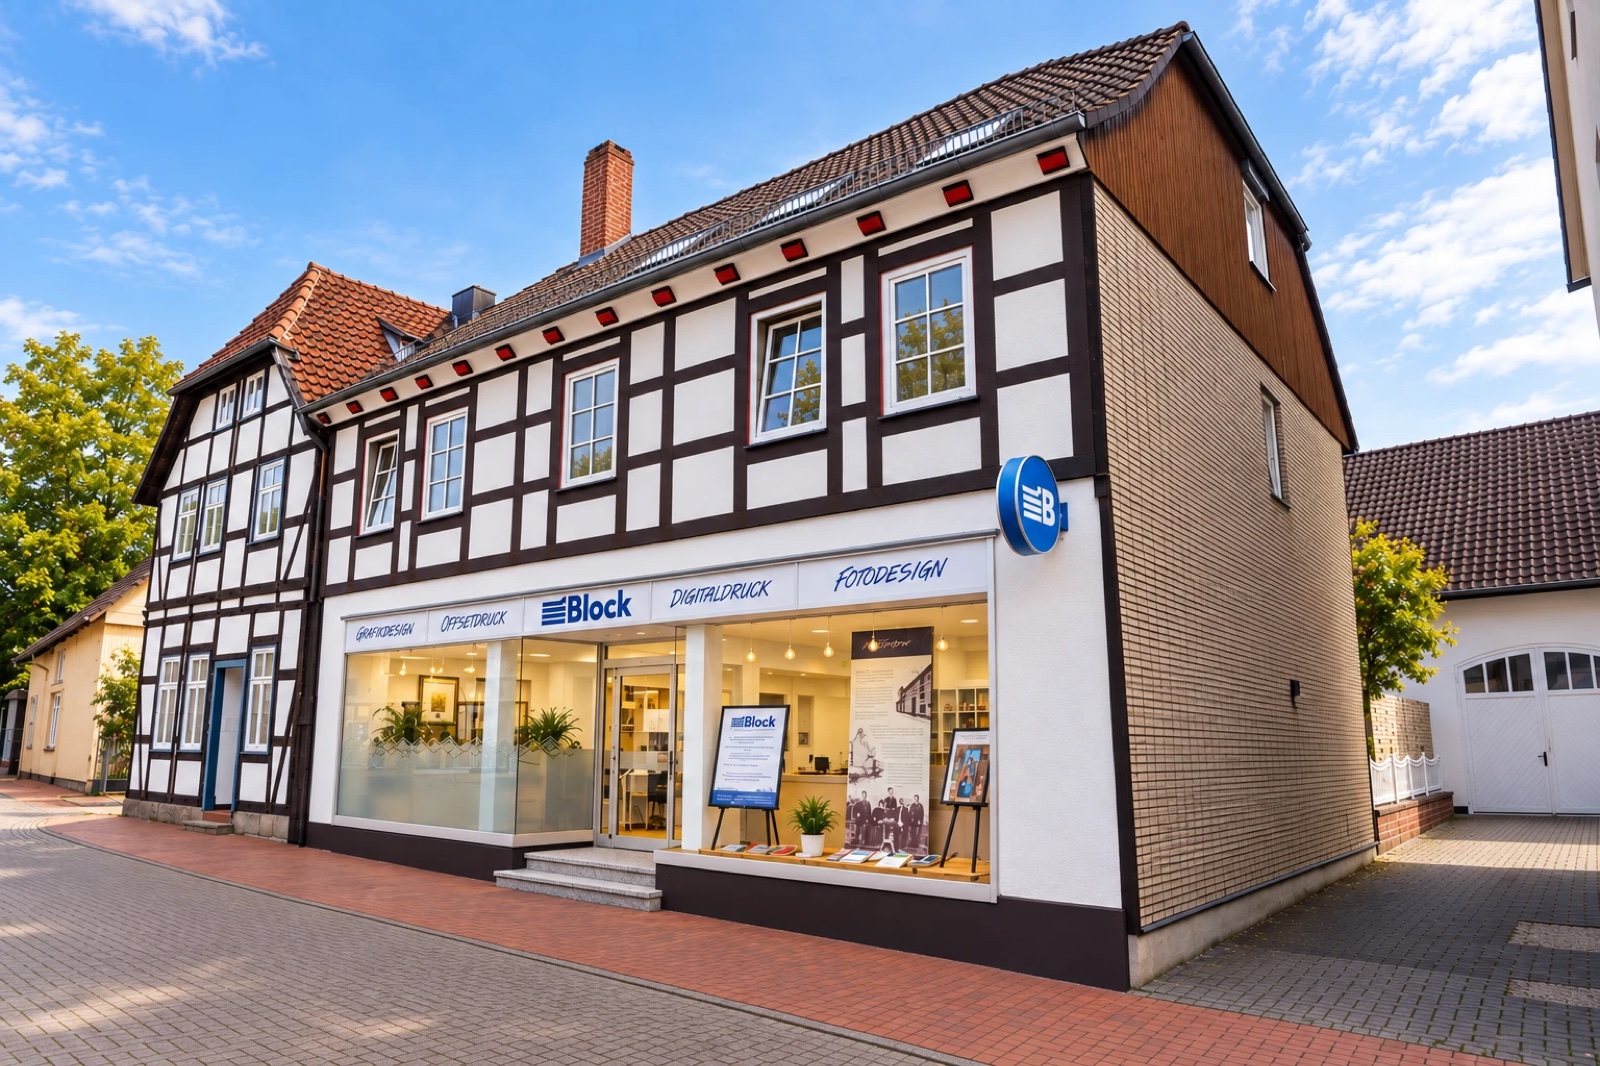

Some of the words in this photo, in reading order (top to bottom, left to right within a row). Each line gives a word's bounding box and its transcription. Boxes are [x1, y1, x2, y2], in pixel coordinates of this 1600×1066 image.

[834, 557, 949, 592] FOTODESIGN
[566, 589, 632, 624] Block
[670, 580, 773, 608] DIGITALDRUCK
[356, 622, 415, 642] GRAFIKDESIGN
[441, 610, 508, 633] OFFSETDRUCK
[744, 715, 776, 728] Block
